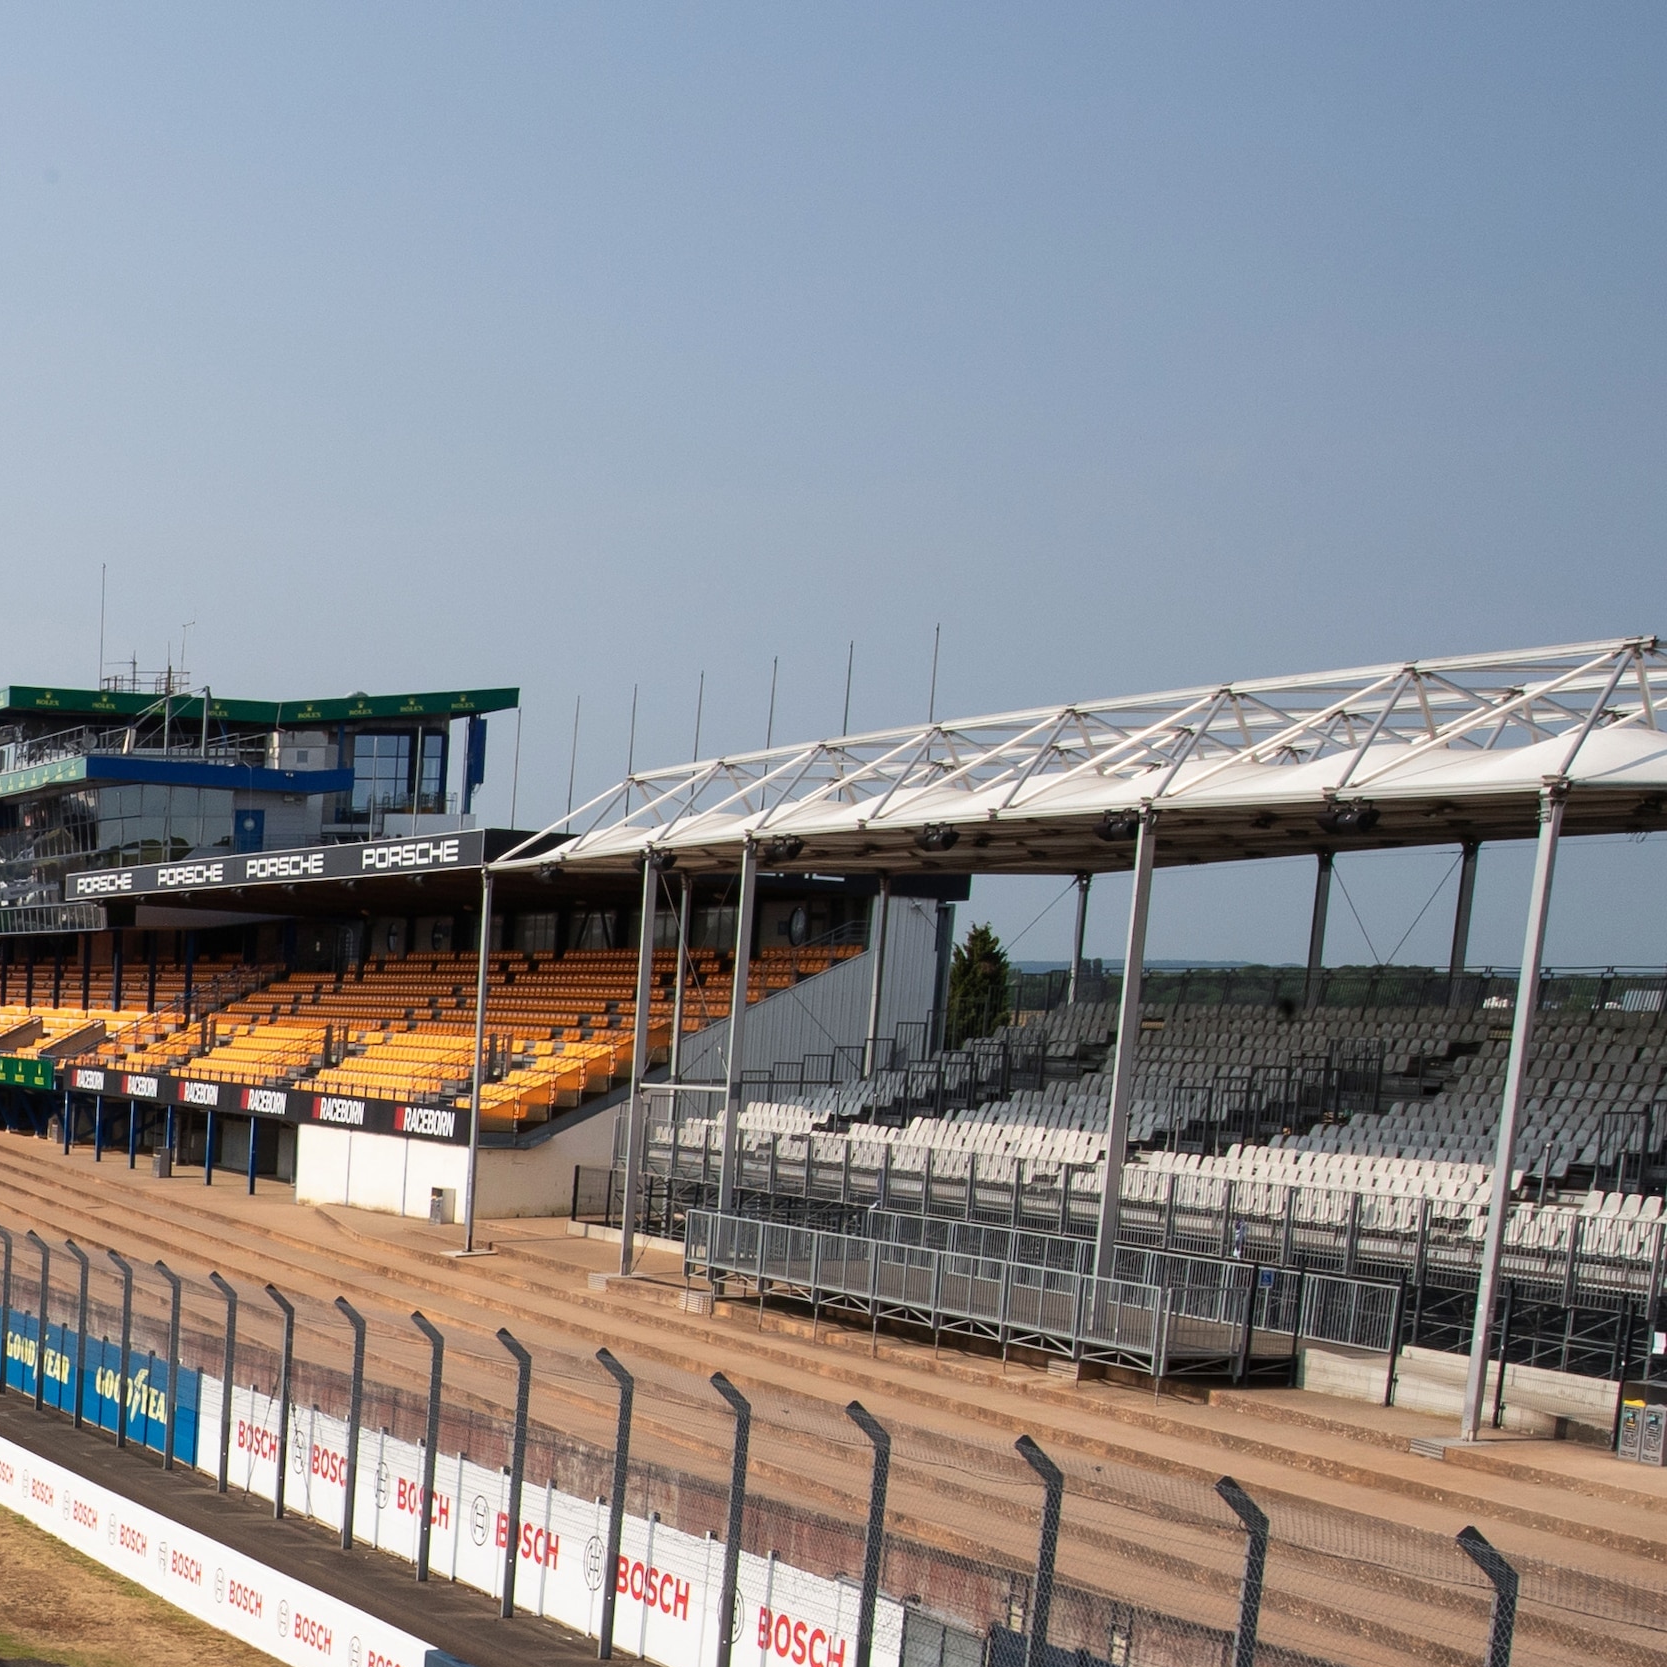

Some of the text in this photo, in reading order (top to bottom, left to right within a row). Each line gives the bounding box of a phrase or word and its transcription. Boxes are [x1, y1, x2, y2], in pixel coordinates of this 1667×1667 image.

[399, 705, 424, 713] ROLEX
[451, 701, 476, 709] ROLEX
[246, 854, 324, 879] PORSCHE
[362, 840, 459, 869] PORSCHE
[77, 872, 133, 894] PORSCHE
[157, 864, 223, 886] PORSCHE
[77, 1069, 105, 1090] RACEBORN
[127, 1075, 158, 1098] RACEBORN
[184, 1082, 218, 1106] RACEBORN
[247, 1088, 287, 1115] RACEBORN
[320, 1097, 366, 1126] RACEBORN
[403, 1108, 456, 1138] RACEBORN
[237, 1420, 278, 1463] BOSCH
[31, 1478, 54, 1508] BOSCH
[73, 1500, 98, 1532] BOSCH
[119, 1524, 147, 1558] BOSCH
[171, 1550, 202, 1586] BOSCH
[228, 1579, 263, 1620] BOSCH
[616, 1555, 690, 1622] BOSCH
[293, 1613, 333, 1657] BOSCH
